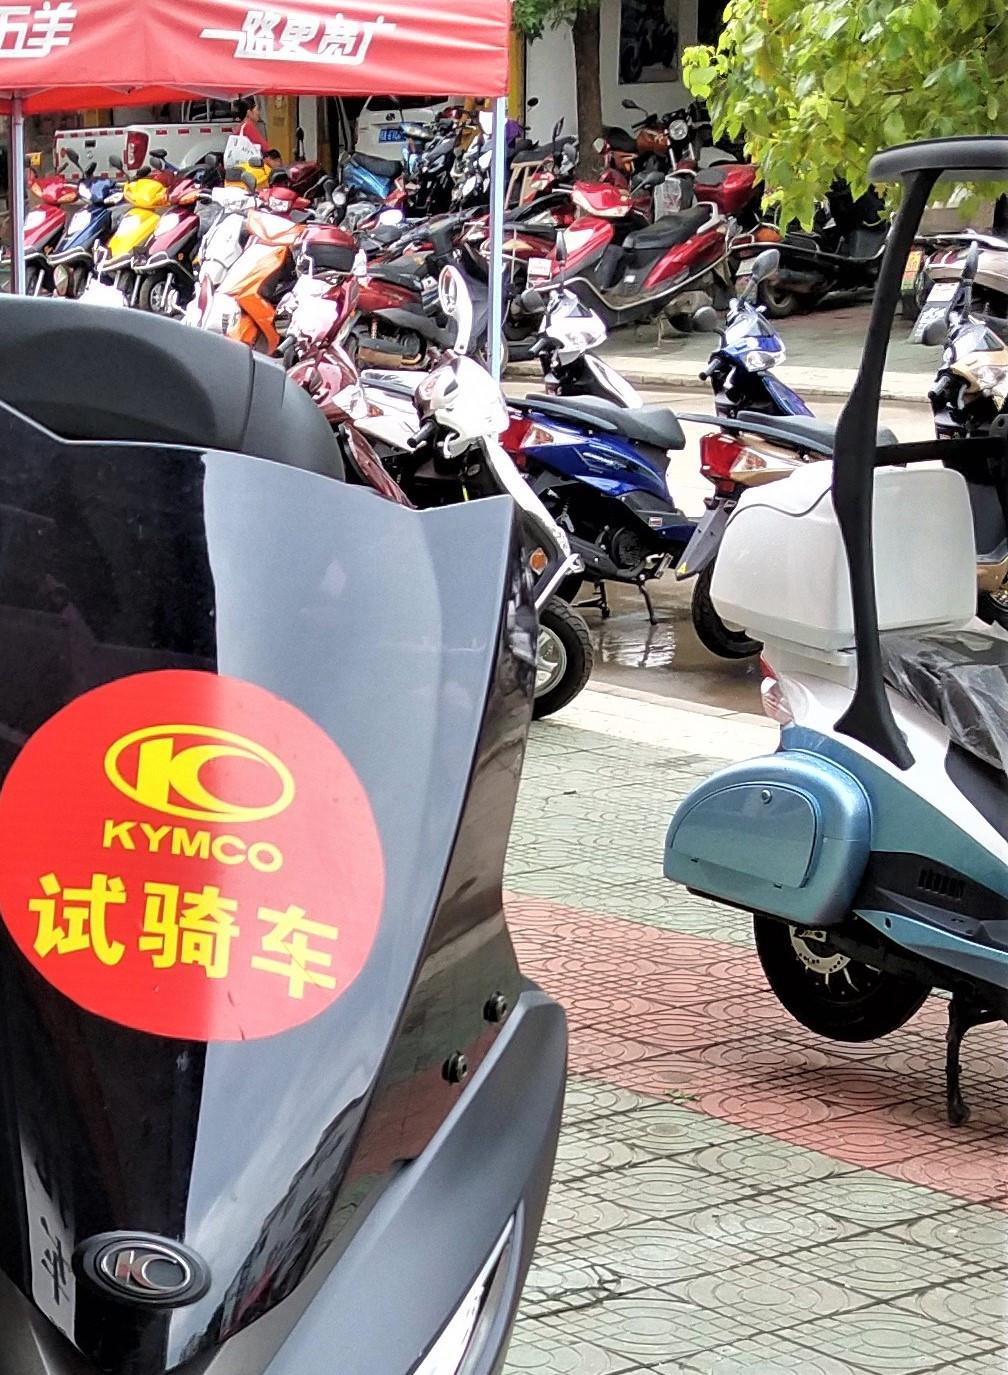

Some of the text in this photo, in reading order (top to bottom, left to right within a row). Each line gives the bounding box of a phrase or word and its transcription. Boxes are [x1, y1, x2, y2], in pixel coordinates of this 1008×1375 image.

[103, 819, 284, 873] KYMCO
[28, 872, 339, 999] 试骑车
